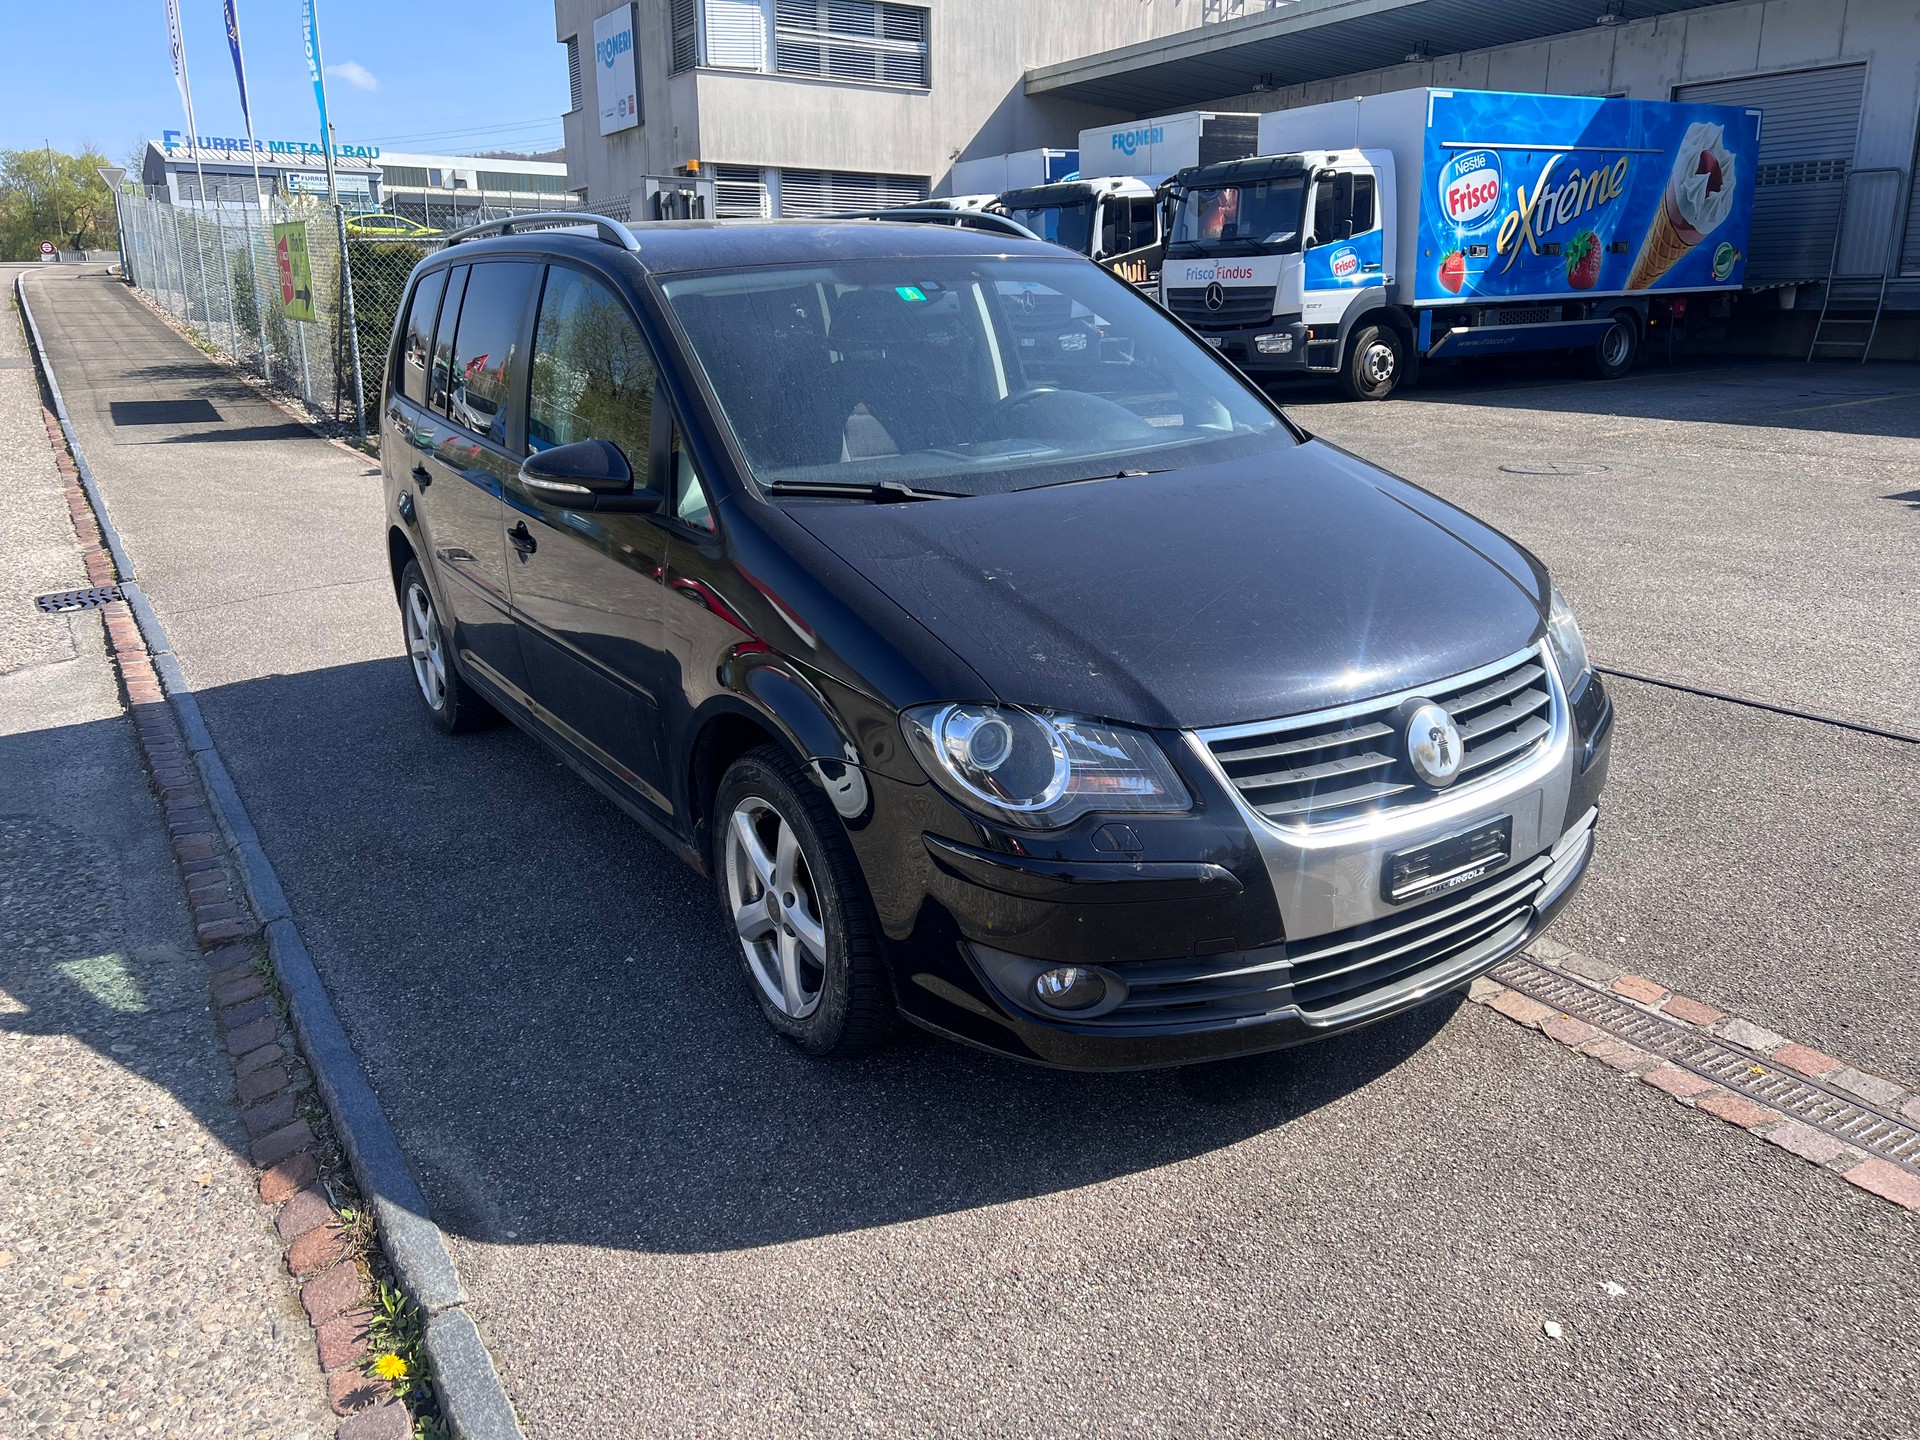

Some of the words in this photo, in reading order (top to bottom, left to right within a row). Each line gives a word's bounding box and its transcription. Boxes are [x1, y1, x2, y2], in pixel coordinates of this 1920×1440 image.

[596, 29, 632, 69] FRONERI
[268, 140, 380, 160] METALBAU
[1112, 126, 1164, 156] FRONERI
[1455, 153, 1486, 177] Nestlé
[1449, 180, 1498, 216] Frisco
[1496, 153, 1629, 275] eXtrême
[1186, 267, 1215, 281] Frisco
[1216, 266, 1253, 280] Findus
[1334, 258, 1357, 275] Frisco
